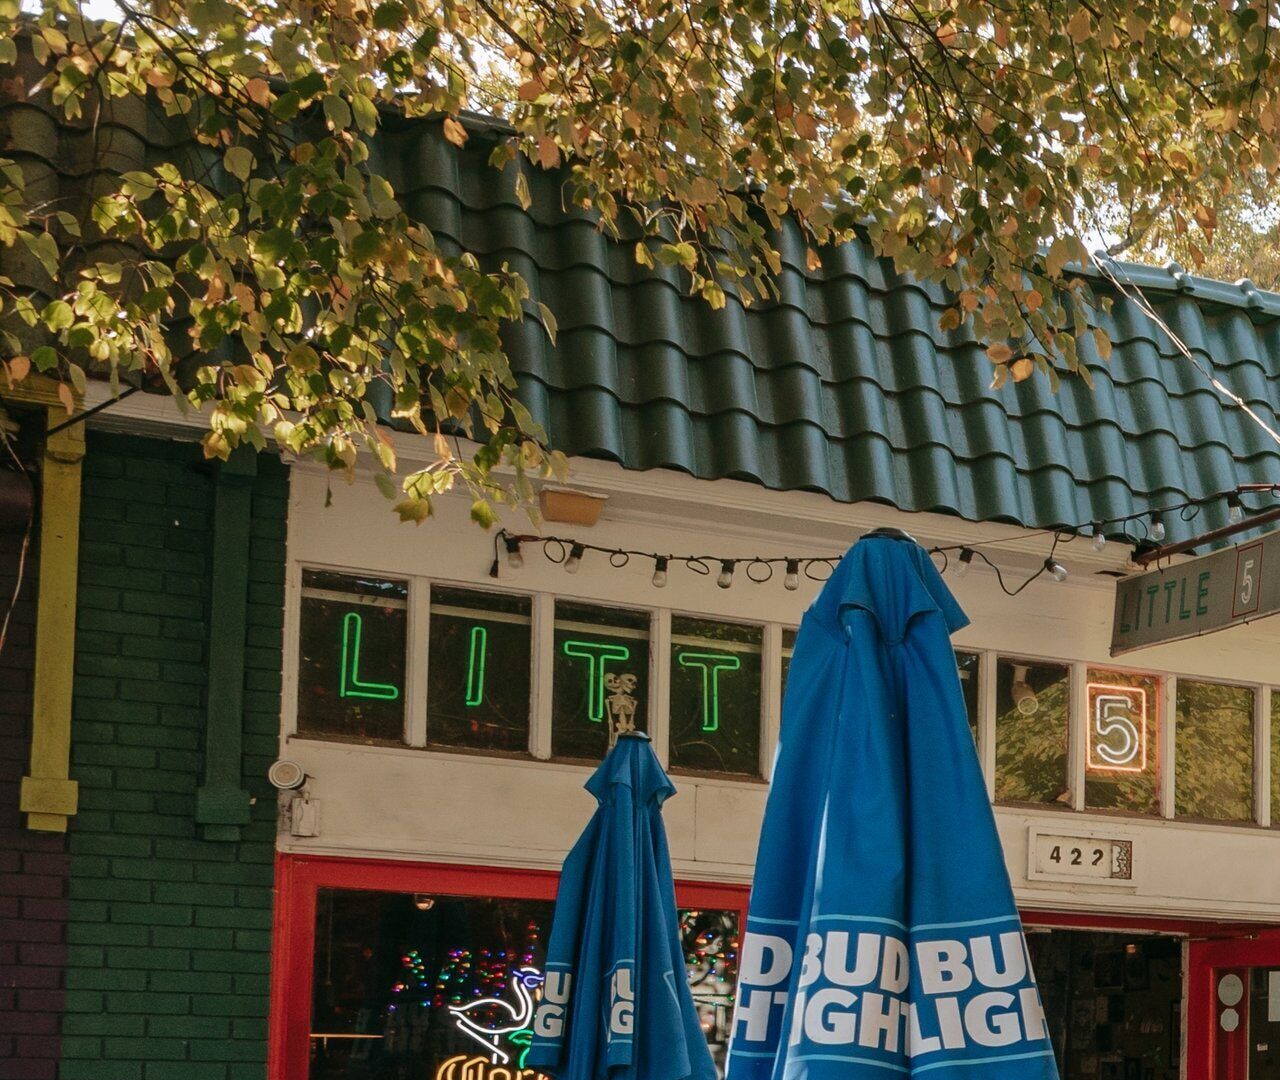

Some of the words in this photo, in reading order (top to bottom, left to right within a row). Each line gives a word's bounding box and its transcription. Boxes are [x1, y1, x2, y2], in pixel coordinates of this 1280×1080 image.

[1119, 571, 1211, 634] LITTLE
[1241, 559, 1254, 605] 5
[340, 612, 741, 732] LITT
[1094, 694, 1142, 765] 5
[916, 931, 1036, 995] BU
[908, 987, 1048, 1057] LIGH
